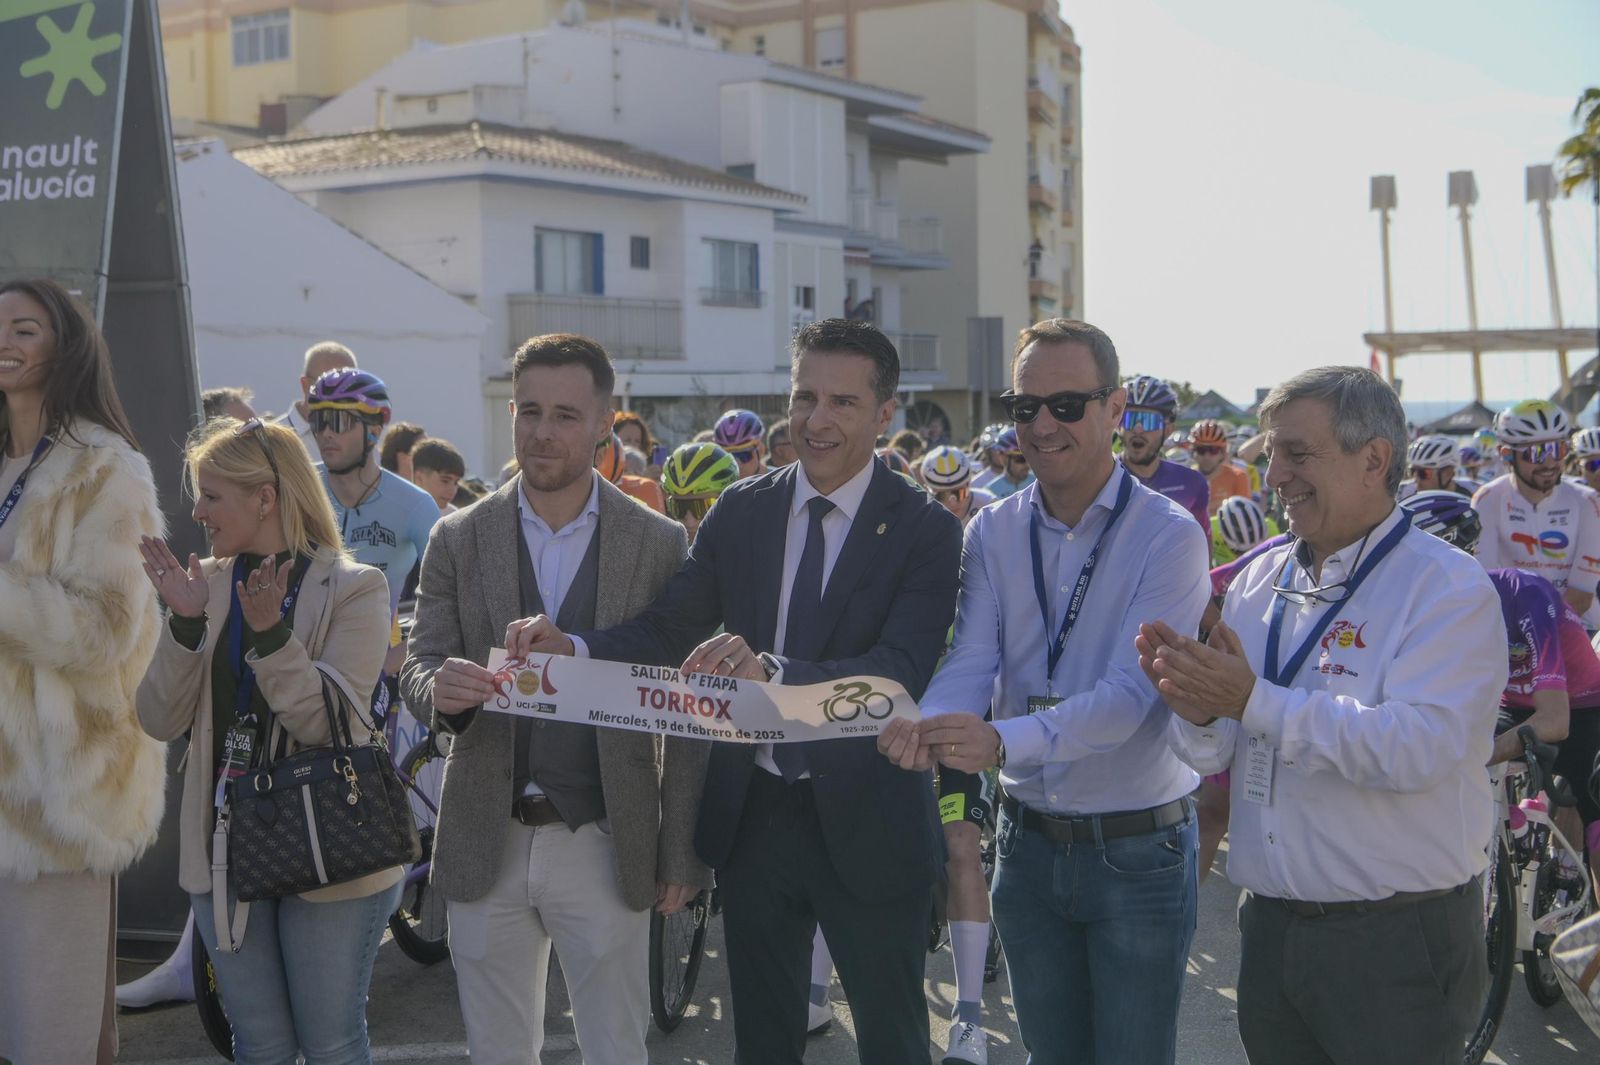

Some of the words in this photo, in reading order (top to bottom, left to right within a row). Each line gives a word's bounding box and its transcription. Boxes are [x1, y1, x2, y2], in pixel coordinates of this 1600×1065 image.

[2, 135, 98, 169] nault
[631, 665, 680, 683] SALIDA
[699, 674, 738, 692] ETAPA
[516, 701, 530, 709] UCI
[637, 686, 733, 721] TORROX
[588, 710, 651, 730] Miercoles,
[655, 718, 667, 730] 19
[670, 720, 684, 733] de
[687, 722, 732, 738] febrero
[735, 729, 751, 739] de
[754, 730, 785, 740] 2025
[840, 725, 879, 733] 1925-2025
[238, 742, 252, 752] SOL
[293, 765, 312, 774] GUESS
